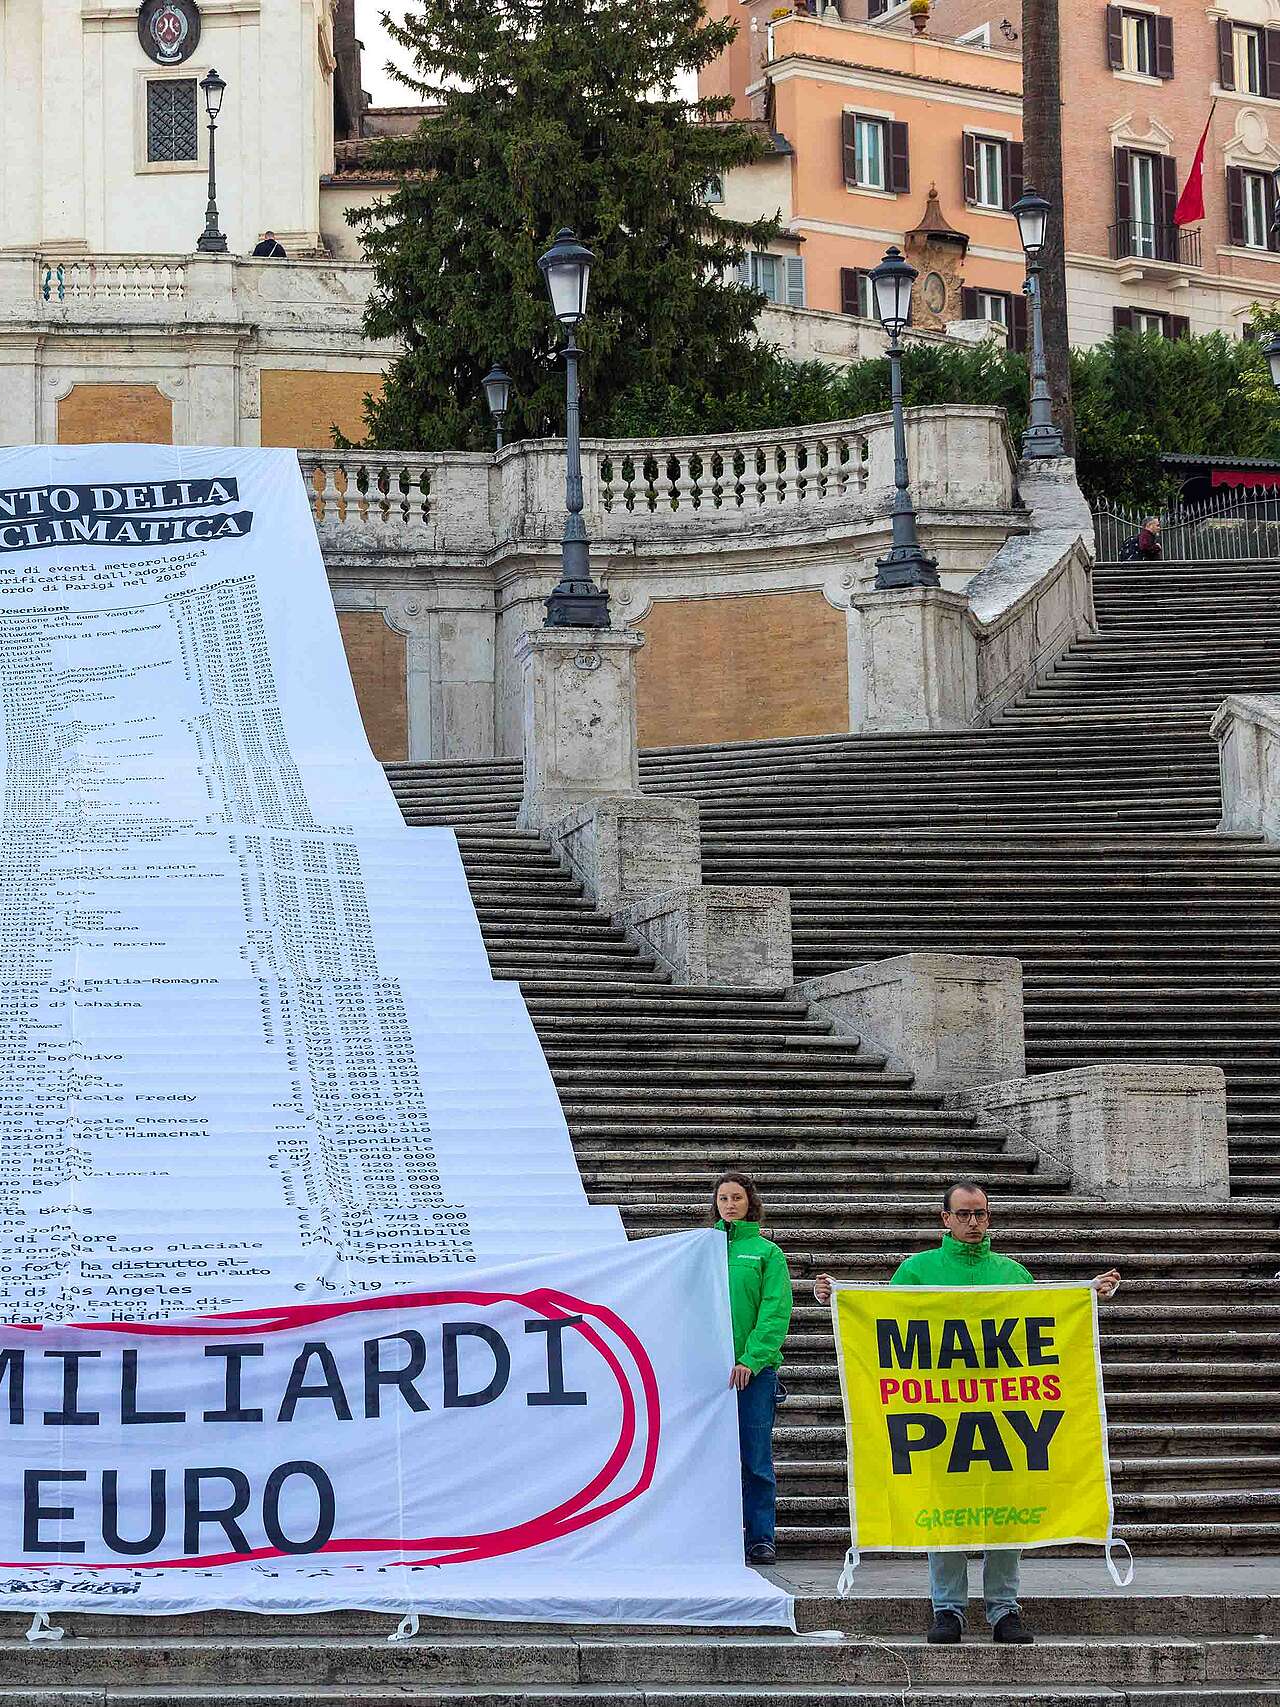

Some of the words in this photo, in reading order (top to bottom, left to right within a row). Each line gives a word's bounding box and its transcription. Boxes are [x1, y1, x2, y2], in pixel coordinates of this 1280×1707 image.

[90, 481, 234, 511] DELLA
[24, 566, 40, 574] di
[49, 563, 96, 573] eventi
[105, 550, 207, 570] meteorologici
[94, 561, 197, 580] dall'adozione
[42, 583, 58, 593] di
[65, 581, 115, 592] Parigi
[123, 578, 147, 587] nel
[156, 571, 187, 583] 2015
[135, 1094, 198, 1102] Freddy
[14, 1234, 38, 1243] di
[106, 1244, 154, 1253] lago
[167, 1241, 263, 1251] glaciale
[81, 1260, 103, 1270] ha
[112, 1260, 208, 1270] distrutto
[106, 1285, 192, 1296] Angeles
[111, 1311, 169, 1322] Heidi
[876, 1316, 1060, 1370] MAKE
[879, 1375, 1062, 1405] POLLUTERS
[886, 1410, 1065, 1475] PAY
[21, 1459, 336, 1557] EURO
[914, 1505, 1048, 1529] GREENPEACE
